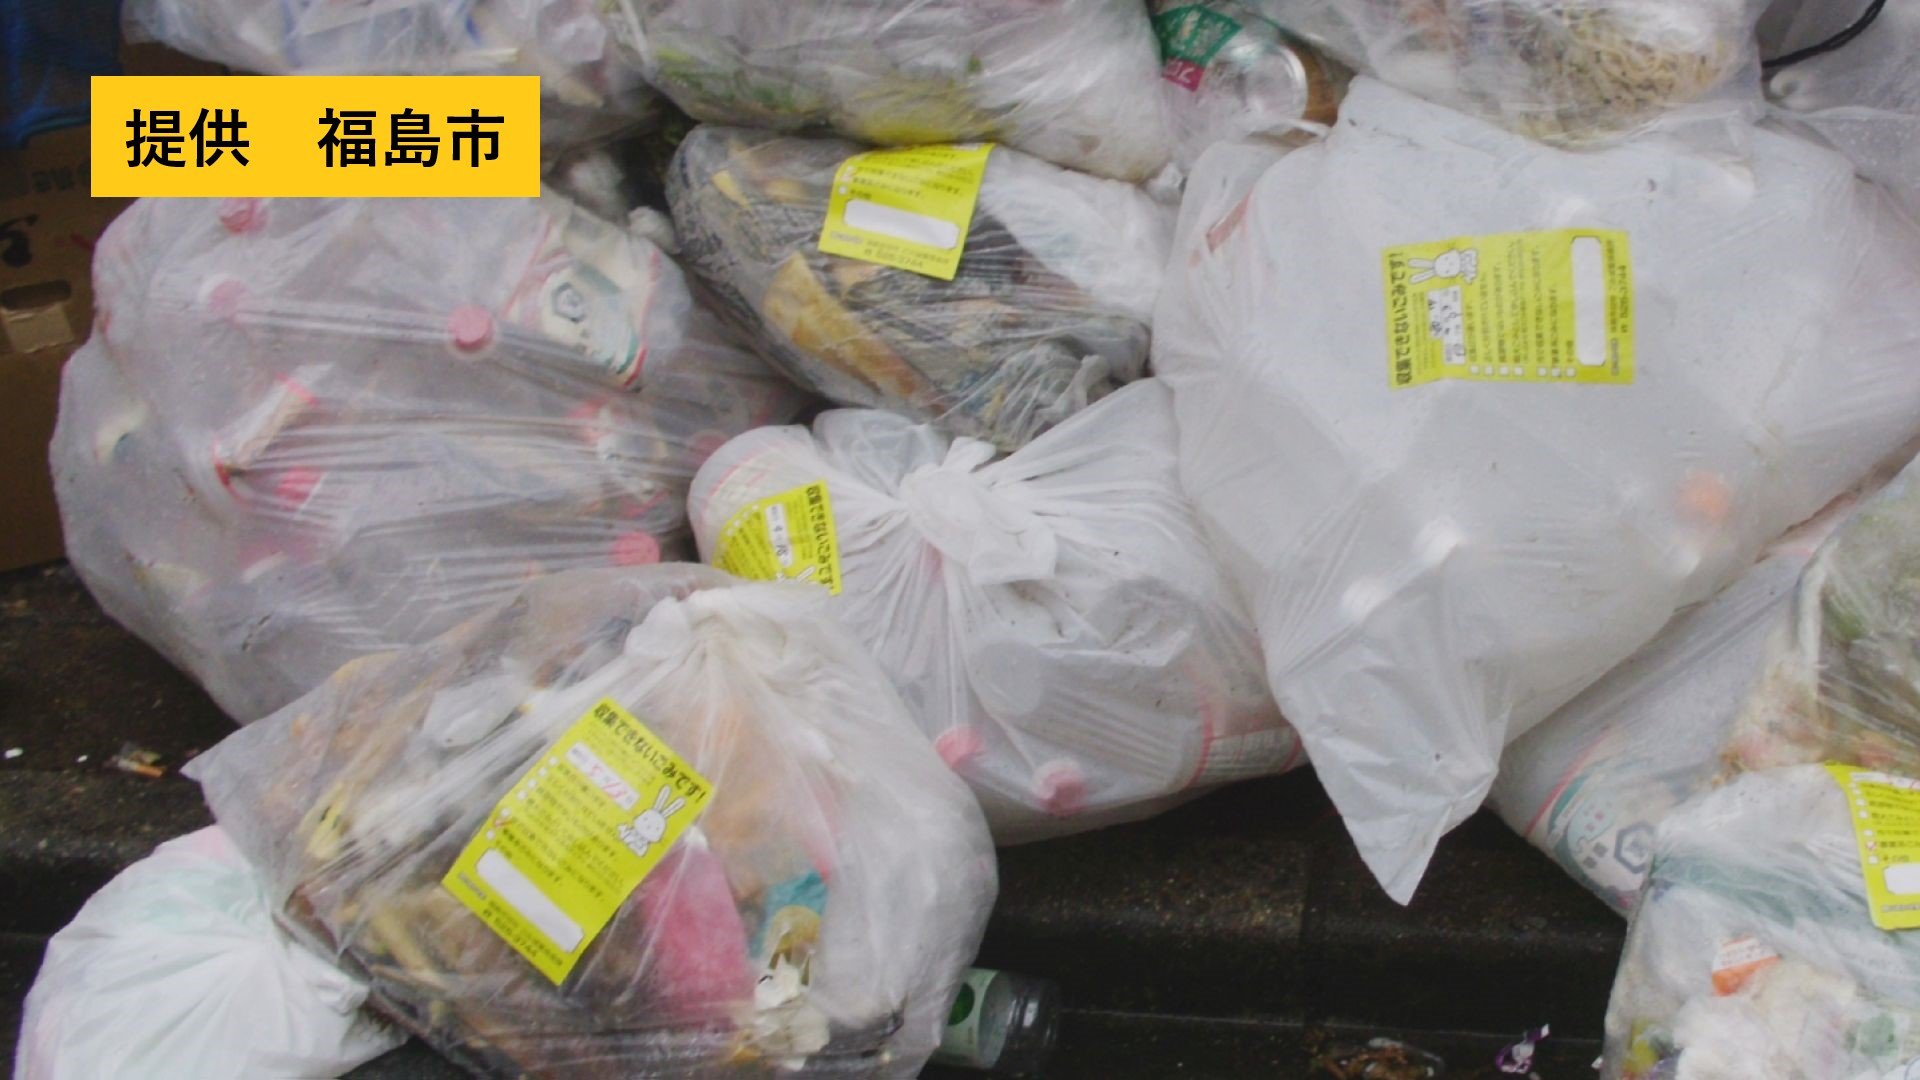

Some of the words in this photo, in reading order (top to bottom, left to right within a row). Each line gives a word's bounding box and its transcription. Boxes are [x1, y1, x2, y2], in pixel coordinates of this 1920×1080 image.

[806, 485, 834, 589] 収集できないごみです
[594, 700, 707, 800] 収集できないごみです!
